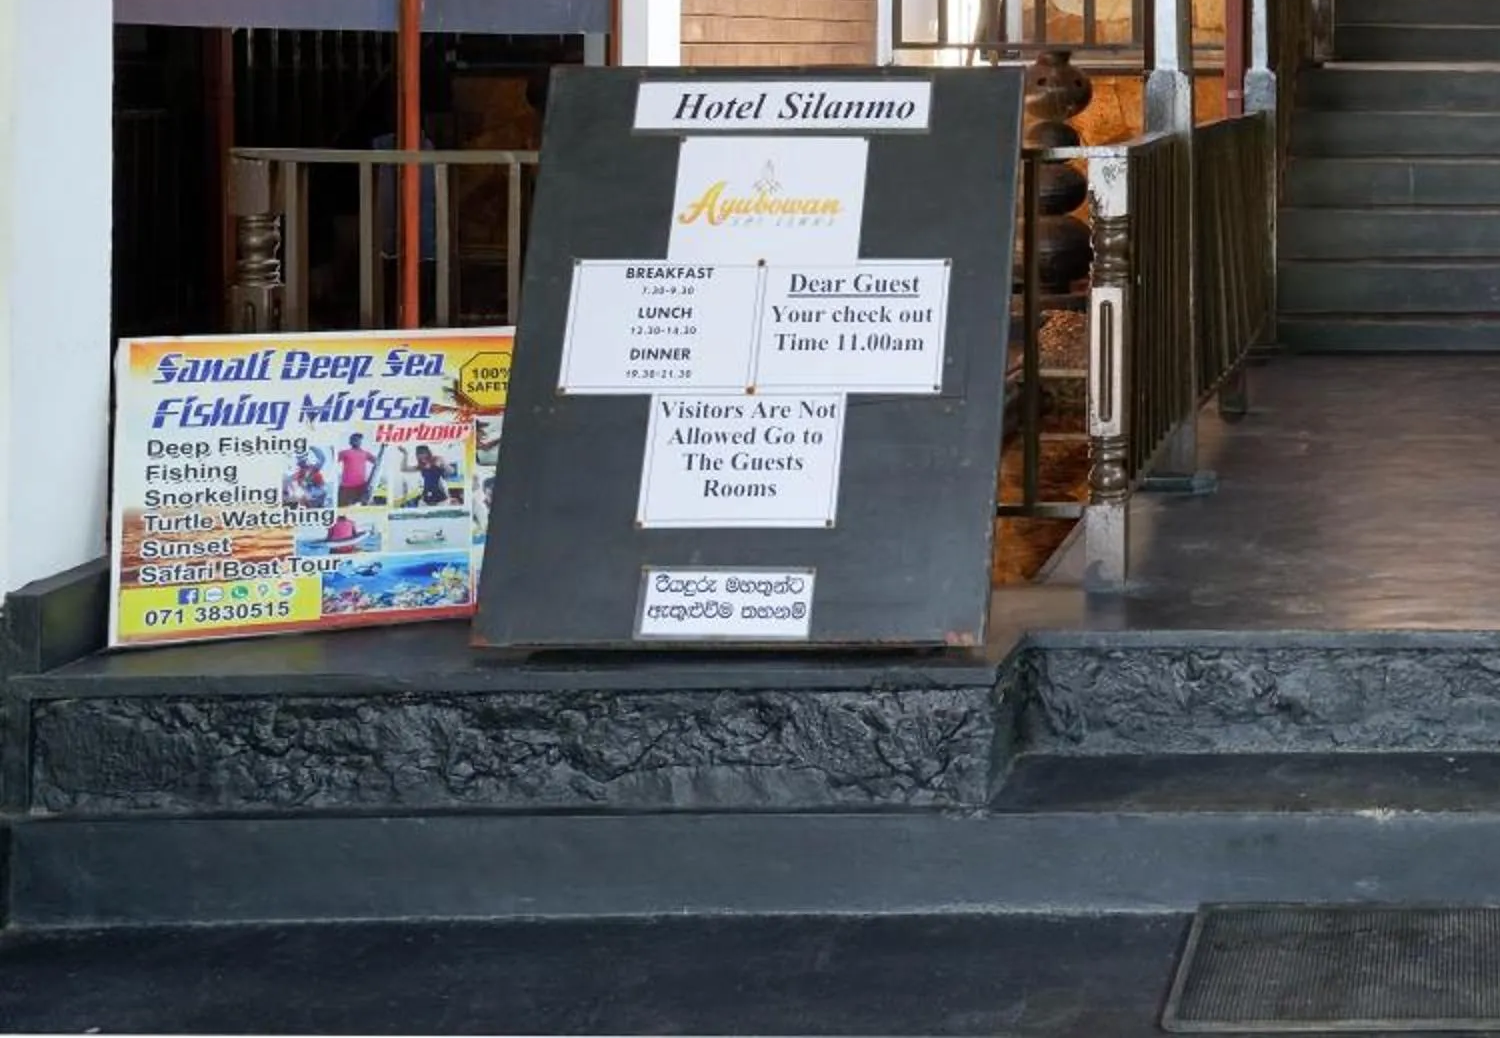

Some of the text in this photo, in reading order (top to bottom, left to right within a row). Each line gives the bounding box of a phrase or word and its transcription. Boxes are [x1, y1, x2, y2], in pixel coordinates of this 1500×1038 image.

[673, 92, 916, 120] Hotel Silanmo
[678, 180, 841, 227] Ayubowan
[625, 267, 715, 279] BREAKFAST
[788, 273, 920, 295] Dear Guest
[637, 307, 693, 319] LUNCH
[771, 304, 933, 324] Your check out
[774, 333, 924, 352] Time 11.00am
[629, 348, 691, 360] DINNER
[280, 351, 374, 384] Deep
[381, 349, 445, 377] Sea
[466, 381, 508, 393] SAFET
[152, 389, 431, 431] Fishing Mirissa
[661, 400, 836, 420] Visitors Are Not
[375, 422, 469, 443] Harbour
[668, 426, 824, 446] Allowed Go to
[146, 435, 308, 459] Deep Fishing
[145, 462, 238, 483] Fishing
[682, 452, 804, 472] The Guests
[144, 485, 278, 507] Snorkeling
[702, 478, 777, 498] Rooms
[143, 507, 335, 532] Turtle Watching
[142, 537, 232, 558] Sunset
[140, 556, 340, 583] Safari Boat Tour
[144, 601, 290, 626] 071 3830515
